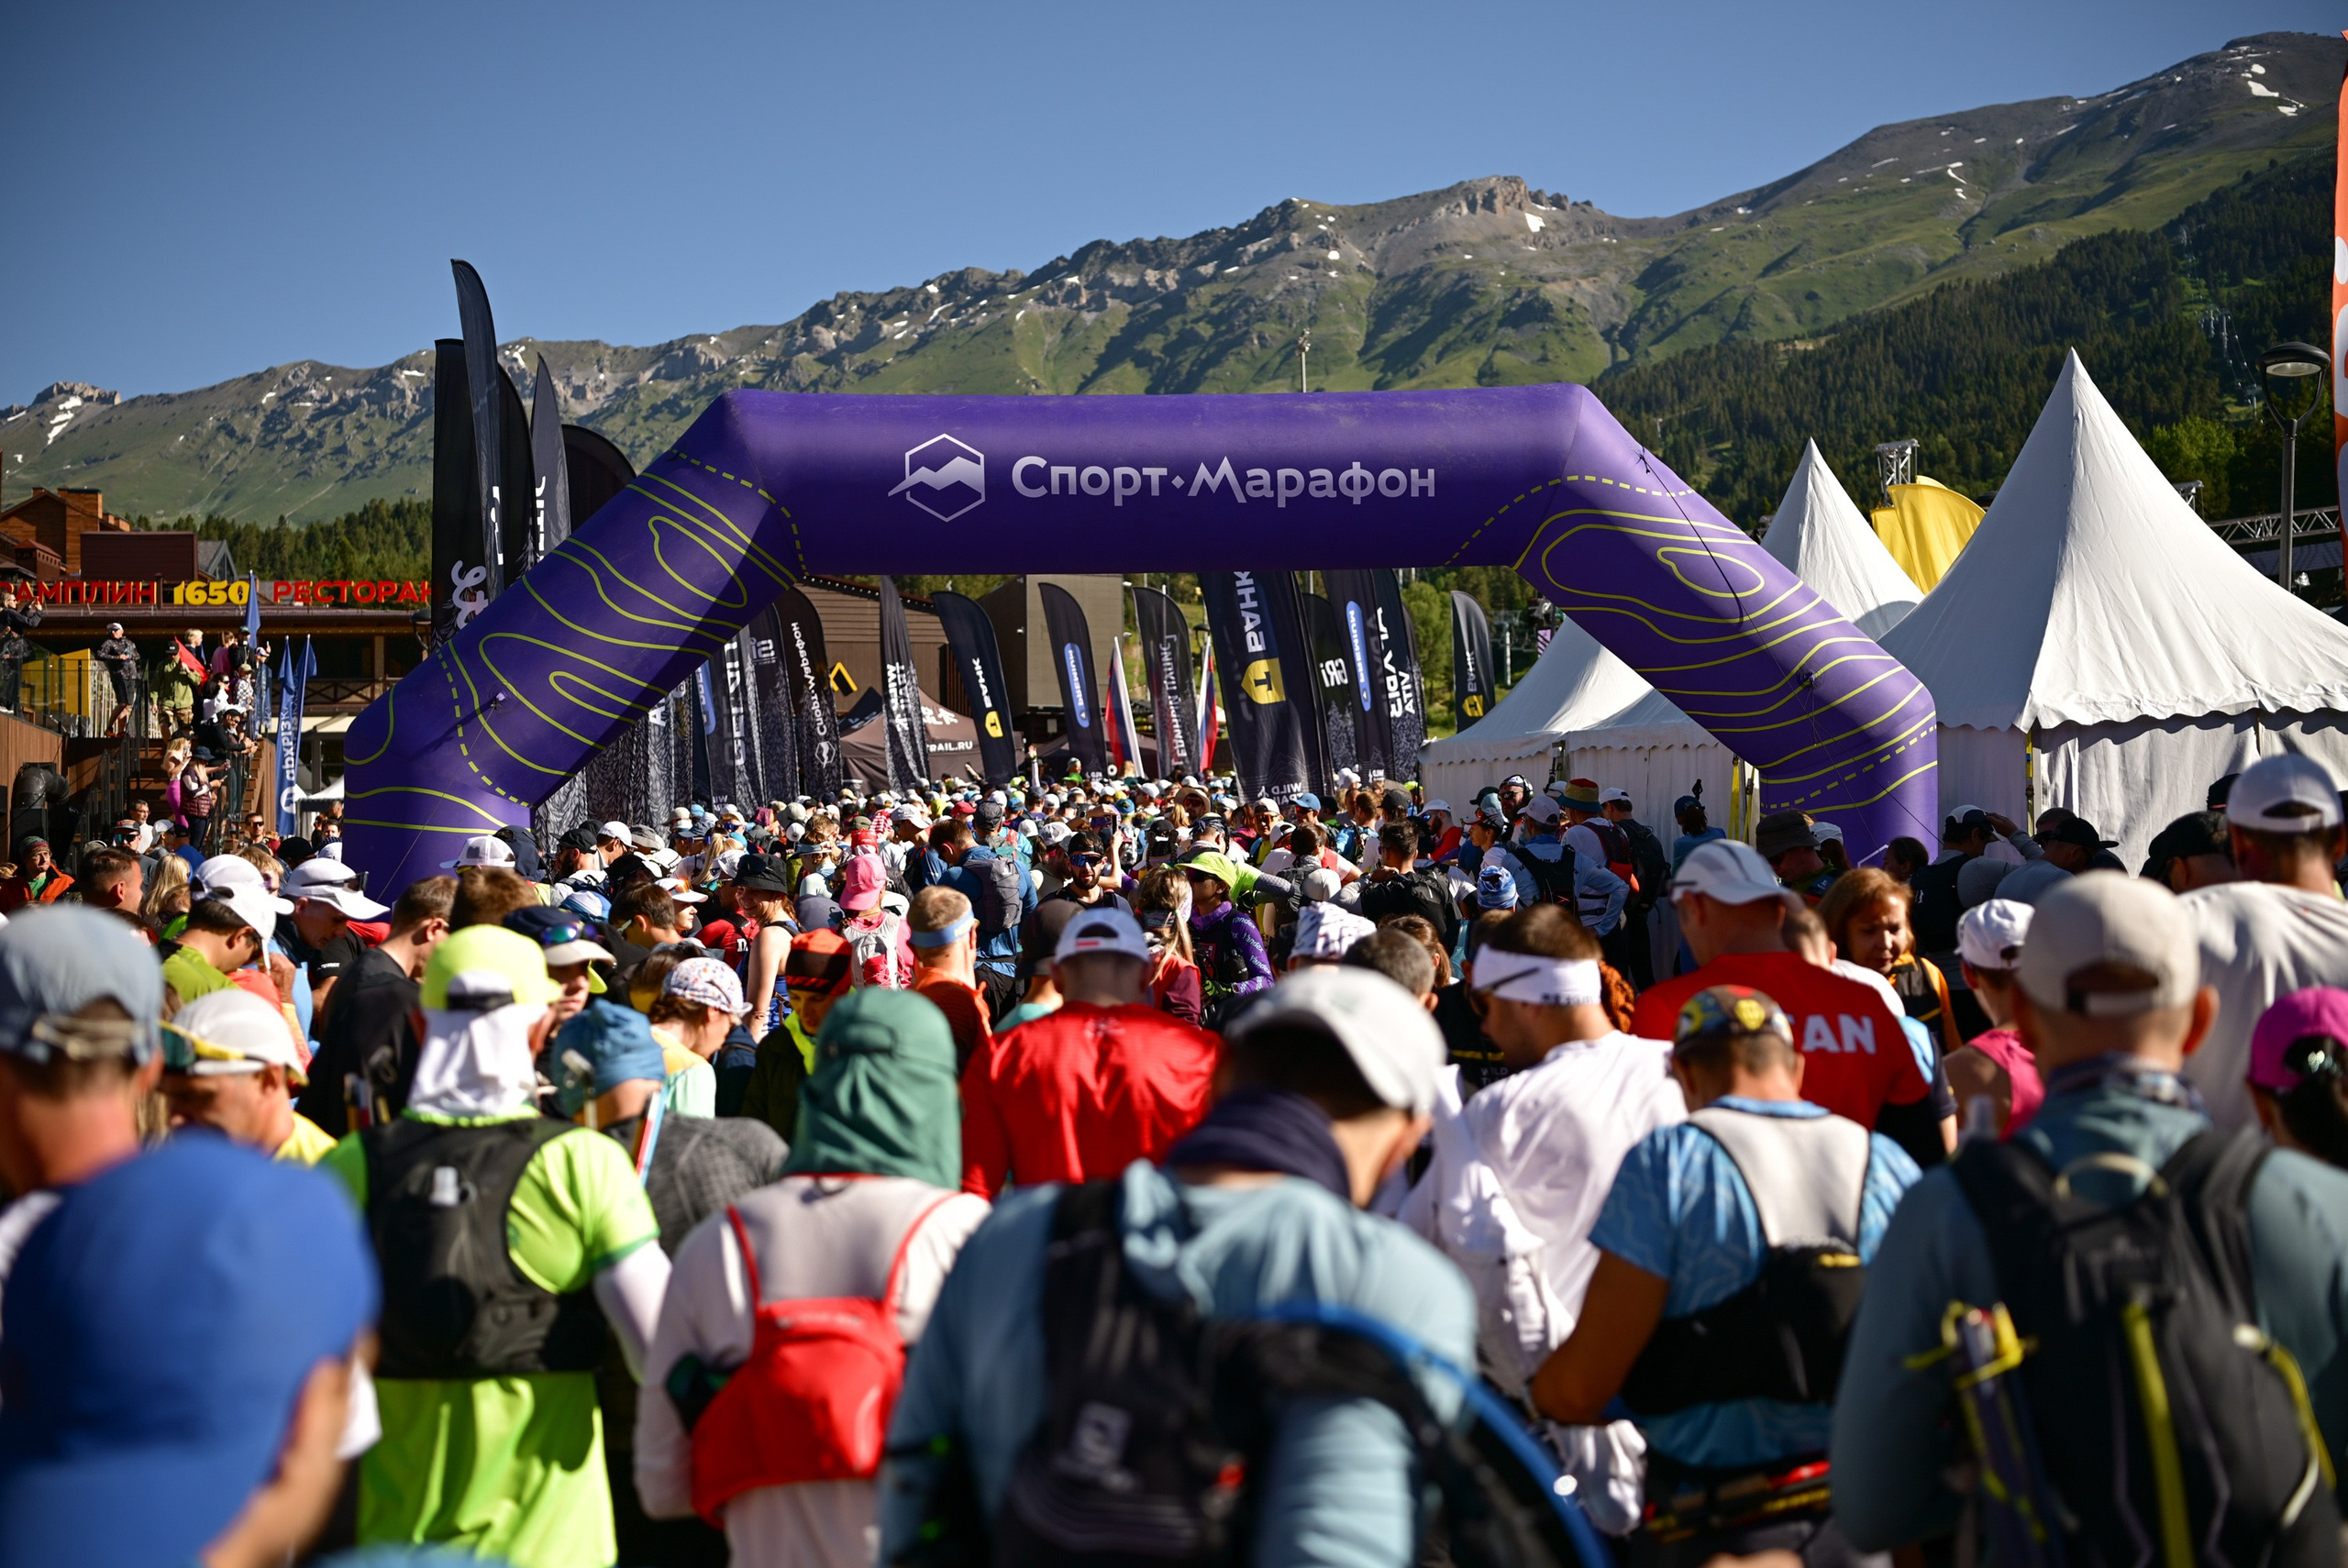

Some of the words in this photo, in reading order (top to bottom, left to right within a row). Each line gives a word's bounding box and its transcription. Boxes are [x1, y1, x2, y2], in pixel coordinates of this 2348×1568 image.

[173, 580, 249, 606] 1650
[1243, 933, 1264, 953] Yandex
[1249, 955, 1271, 975] Yandex
[1788, 1013, 1877, 1055] AN
